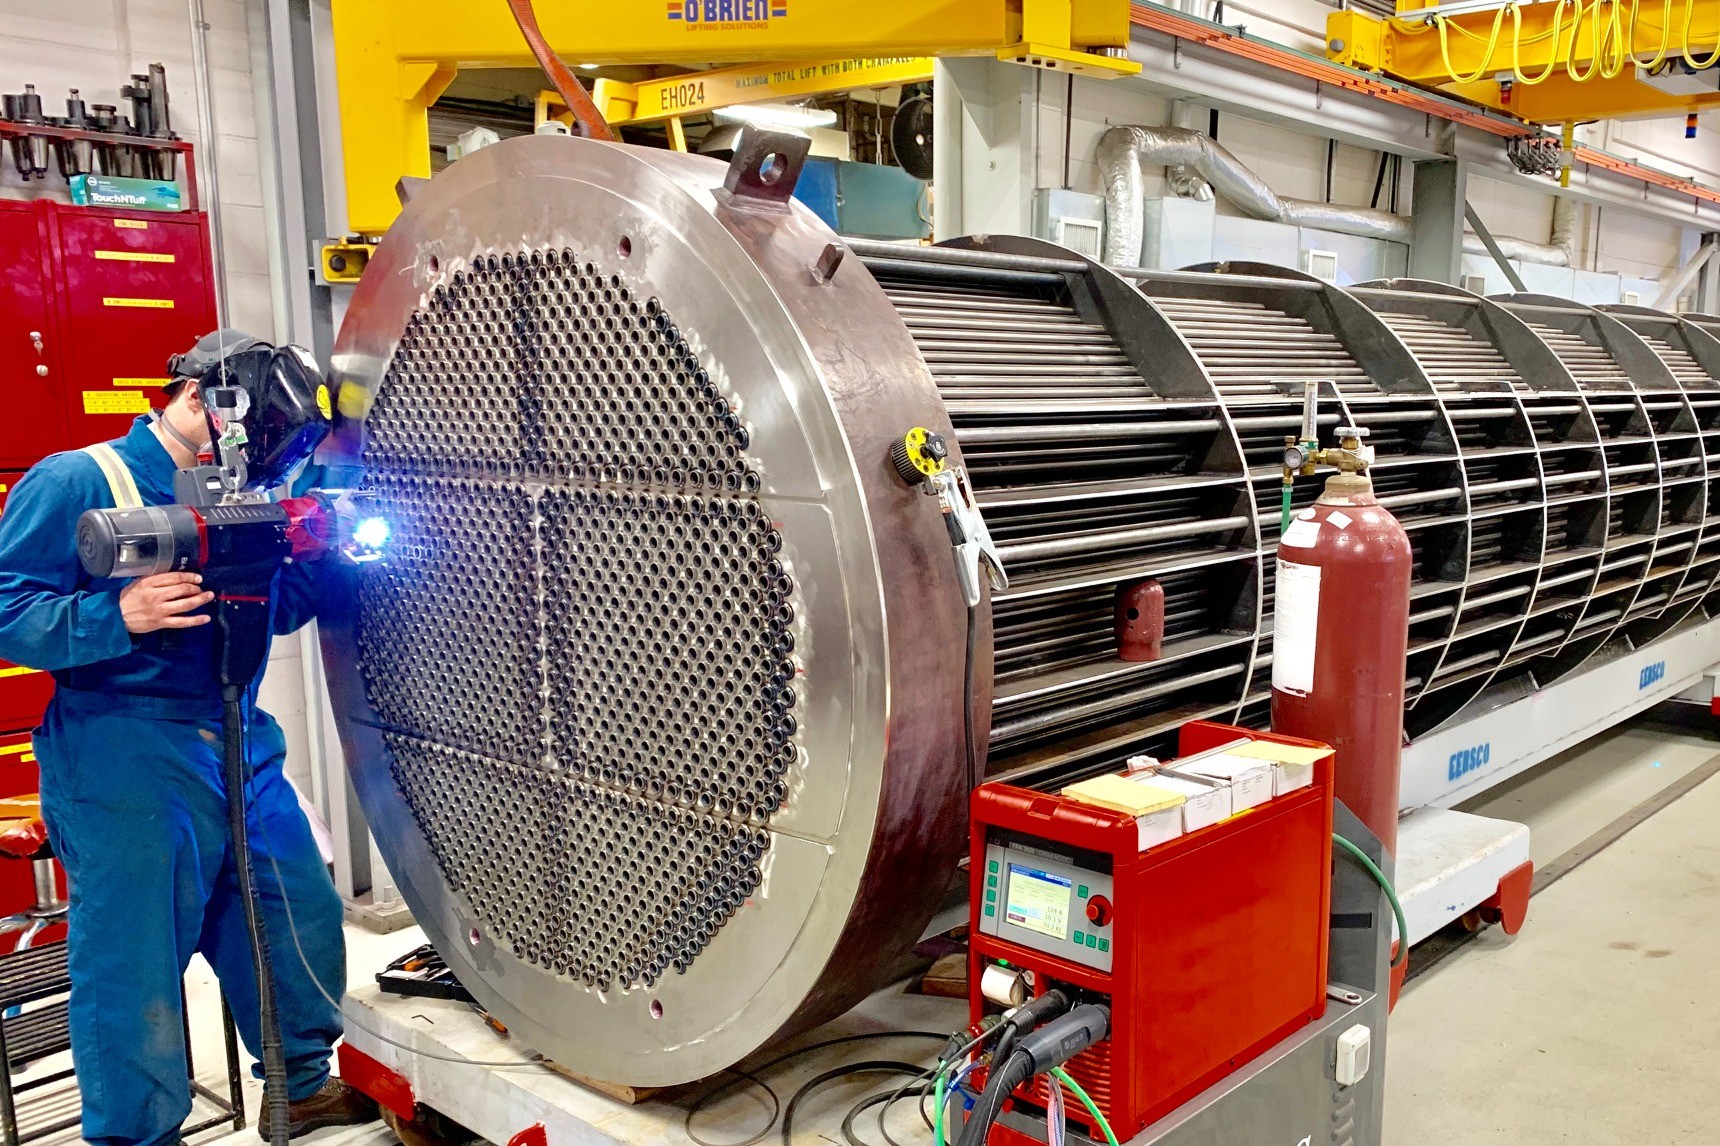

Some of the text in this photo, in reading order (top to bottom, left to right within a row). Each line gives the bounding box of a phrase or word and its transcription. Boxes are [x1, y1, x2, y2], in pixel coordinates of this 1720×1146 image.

[685, 0, 769, 22] O'BRIEN
[686, 22, 769, 31] LIFTING SOLUTIONS
[735, 74, 769, 88] MAXIMUM
[773, 70, 796, 83] TOTAL
[800, 66, 817, 79] LIFT
[821, 62, 840, 76] WITH
[842, 58, 863, 72] BOTH
[661, 81, 705, 110] EH024
[90, 193, 147, 205] TouchNTuff
